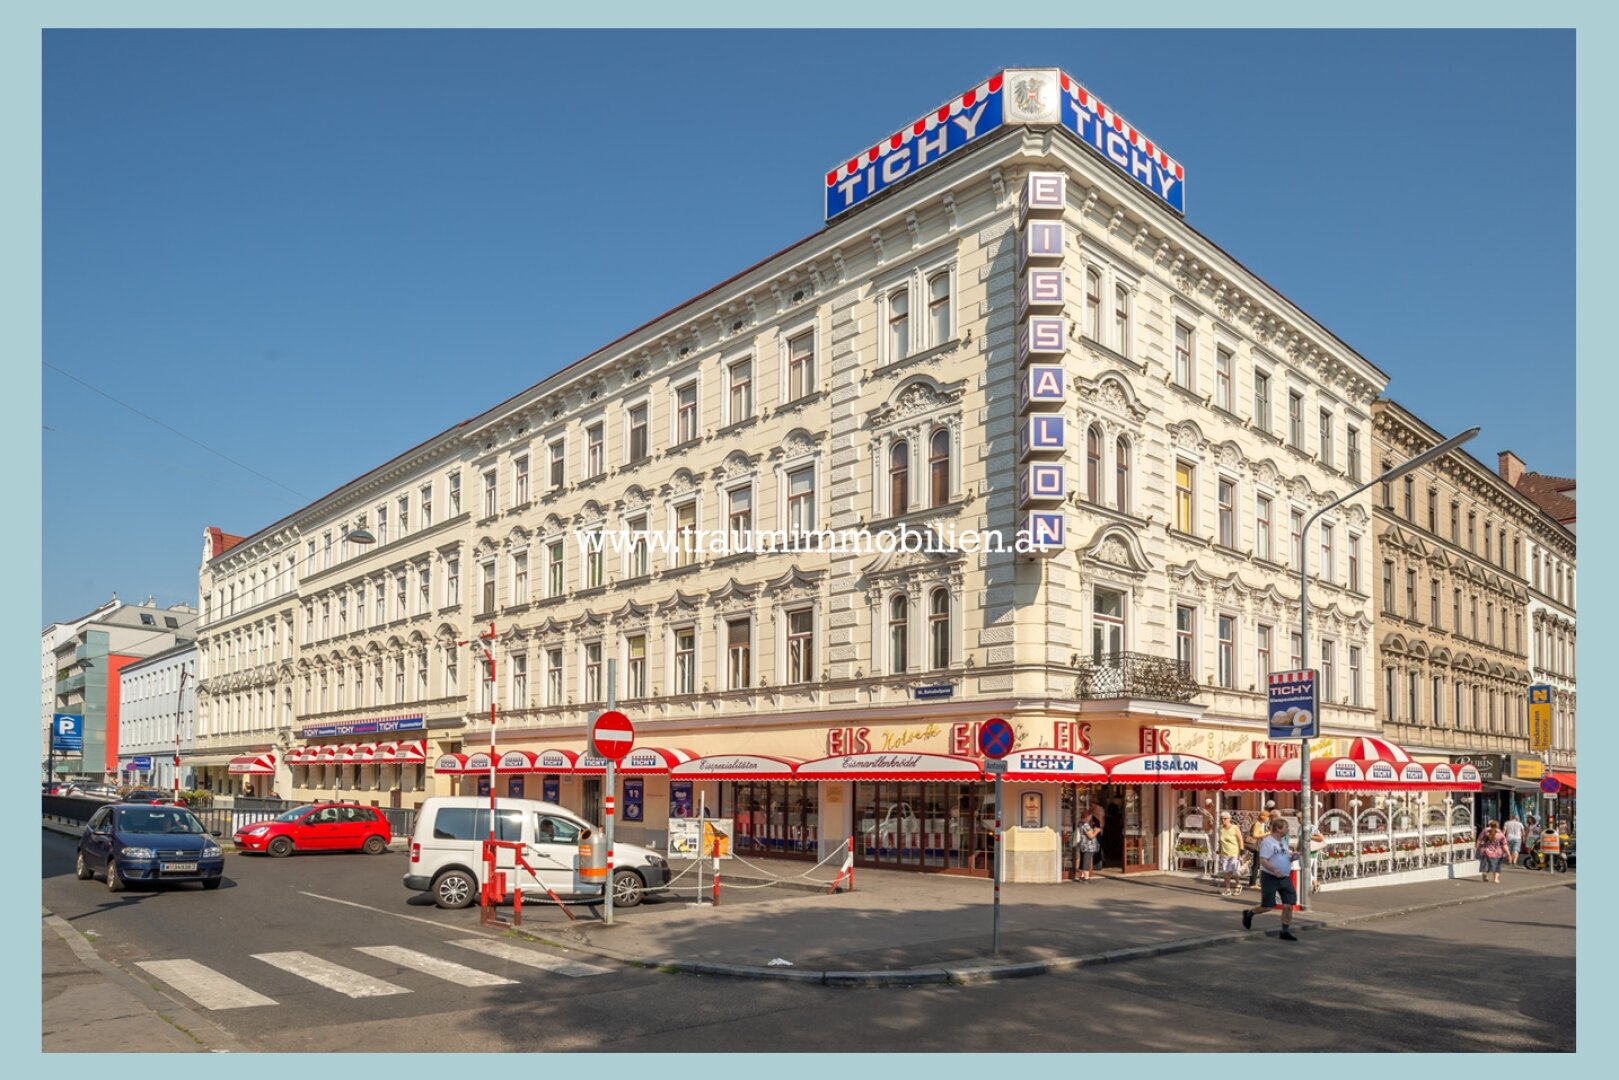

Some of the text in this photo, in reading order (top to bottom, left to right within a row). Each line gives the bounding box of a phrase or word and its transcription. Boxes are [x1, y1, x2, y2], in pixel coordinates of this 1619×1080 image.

[838, 101, 989, 206] TICHY
[1070, 101, 1176, 200] TICHY
[1270, 684, 1312, 696] TICHY
[379, 721, 399, 731] TICHY
[951, 722, 981, 756] EI
[1054, 721, 1092, 754] EIS
[828, 727, 872, 756] EIS
[1022, 760, 1071, 769] TICHY
[1144, 760, 1198, 771] EISSALON
